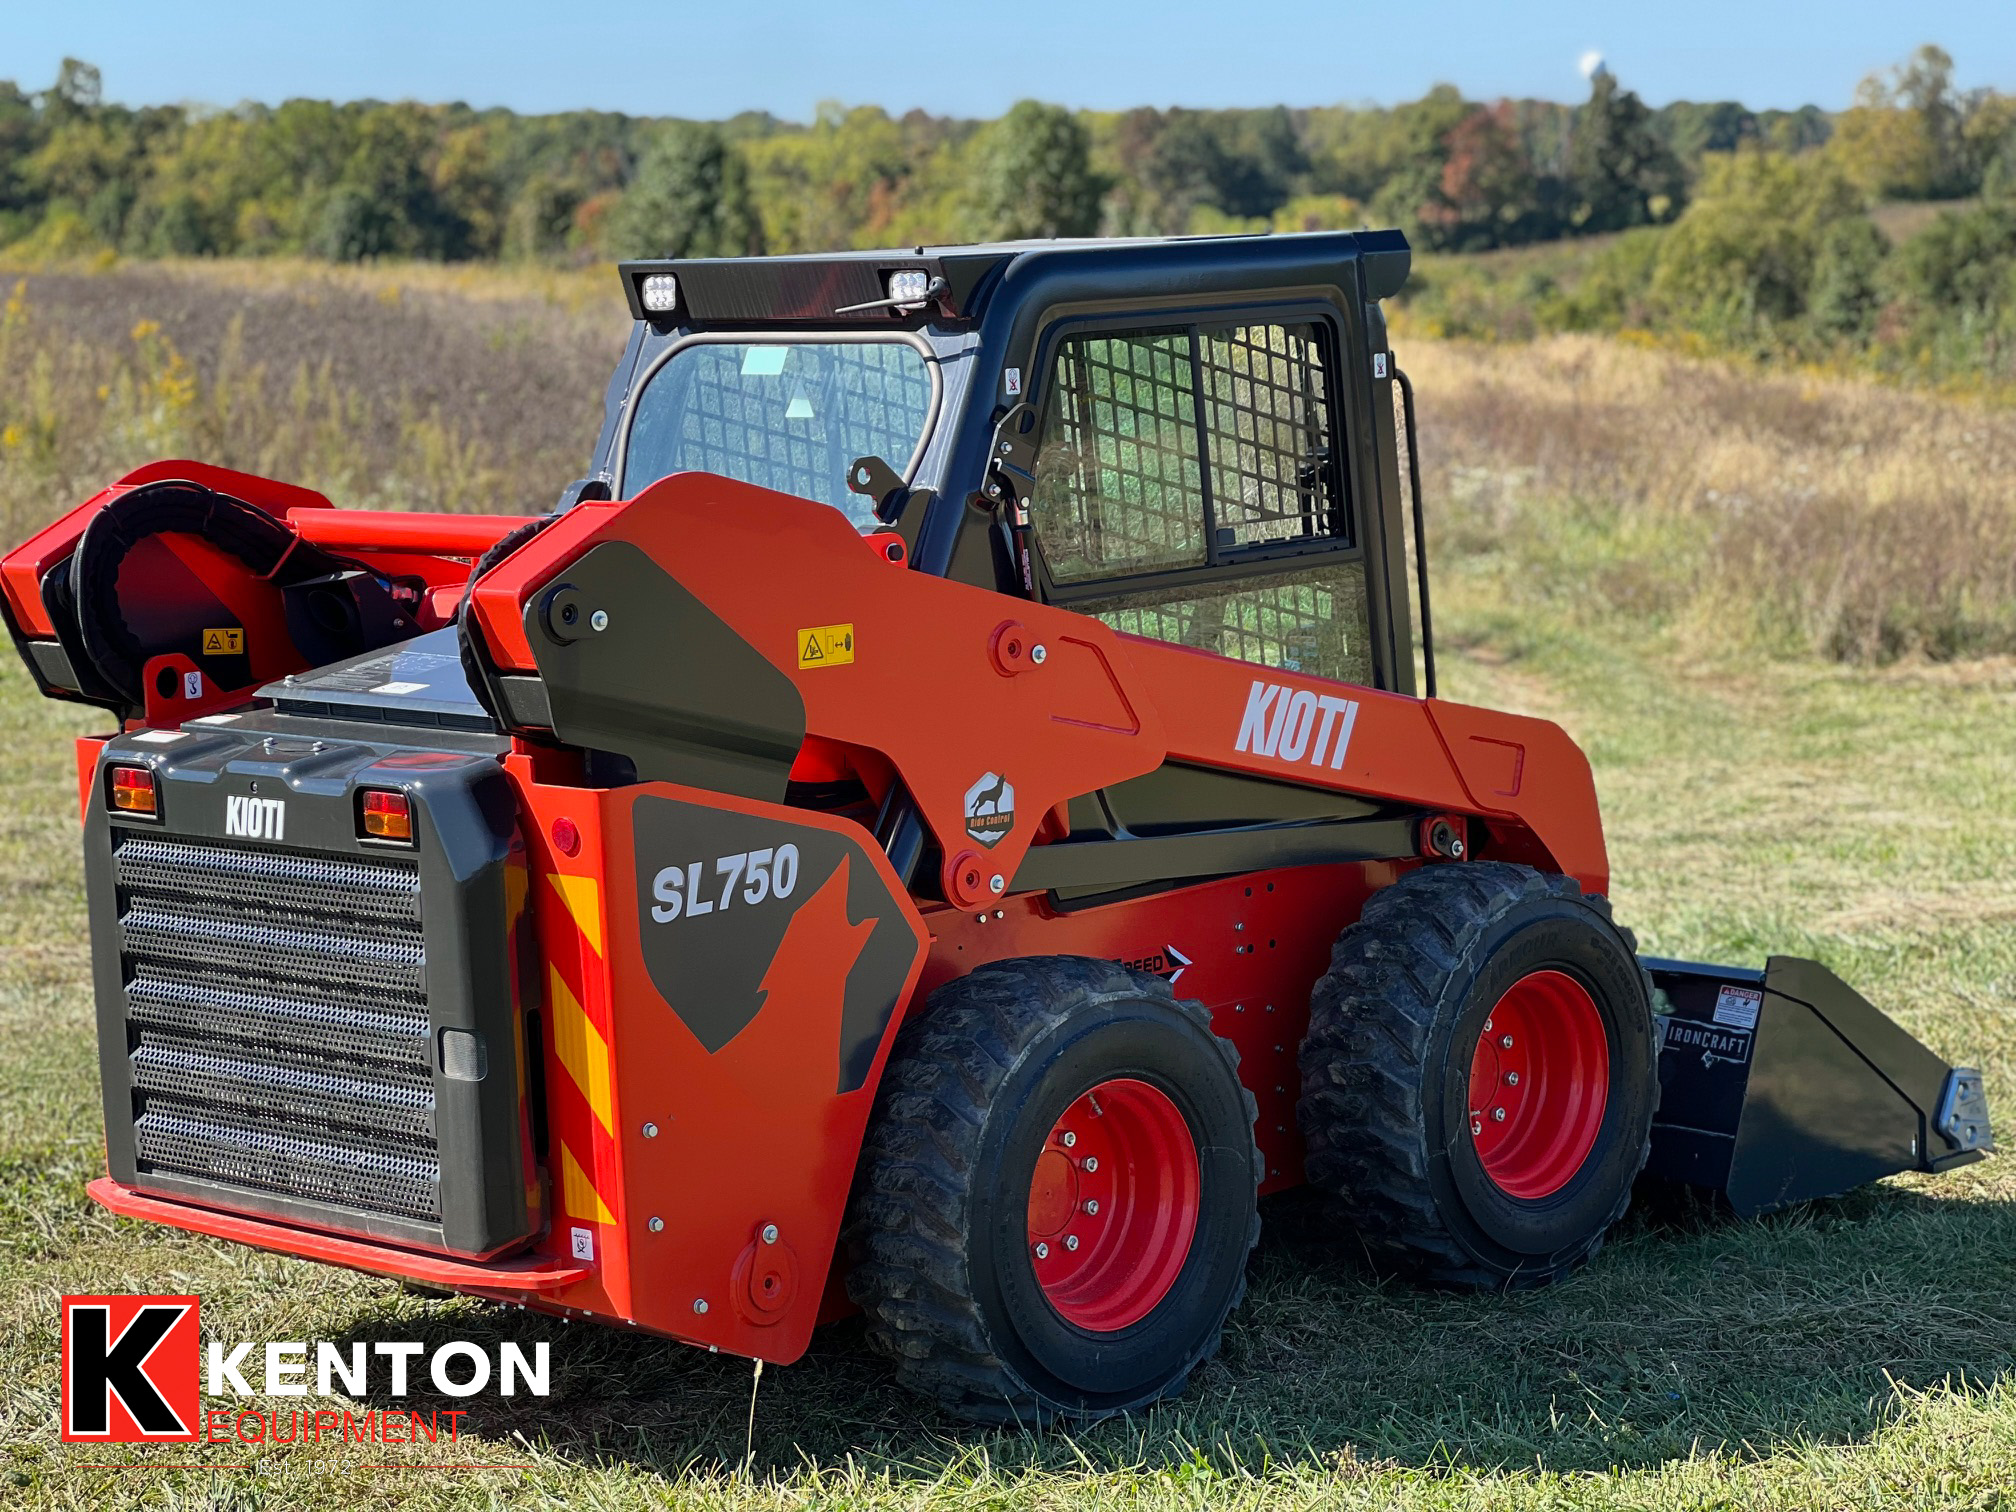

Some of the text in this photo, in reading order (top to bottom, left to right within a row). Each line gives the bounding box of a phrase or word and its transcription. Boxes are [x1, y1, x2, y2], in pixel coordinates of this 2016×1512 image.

[1235, 681, 1359, 769] KIOTI
[226, 796, 285, 840] KIOTI
[970, 814, 1011, 828] Ride Control
[651, 843, 799, 924] SL750
[1112, 955, 1163, 973] PEED
[1730, 988, 1759, 1000] DANGER
[1668, 1026, 1745, 1053] IRONCRAFT
